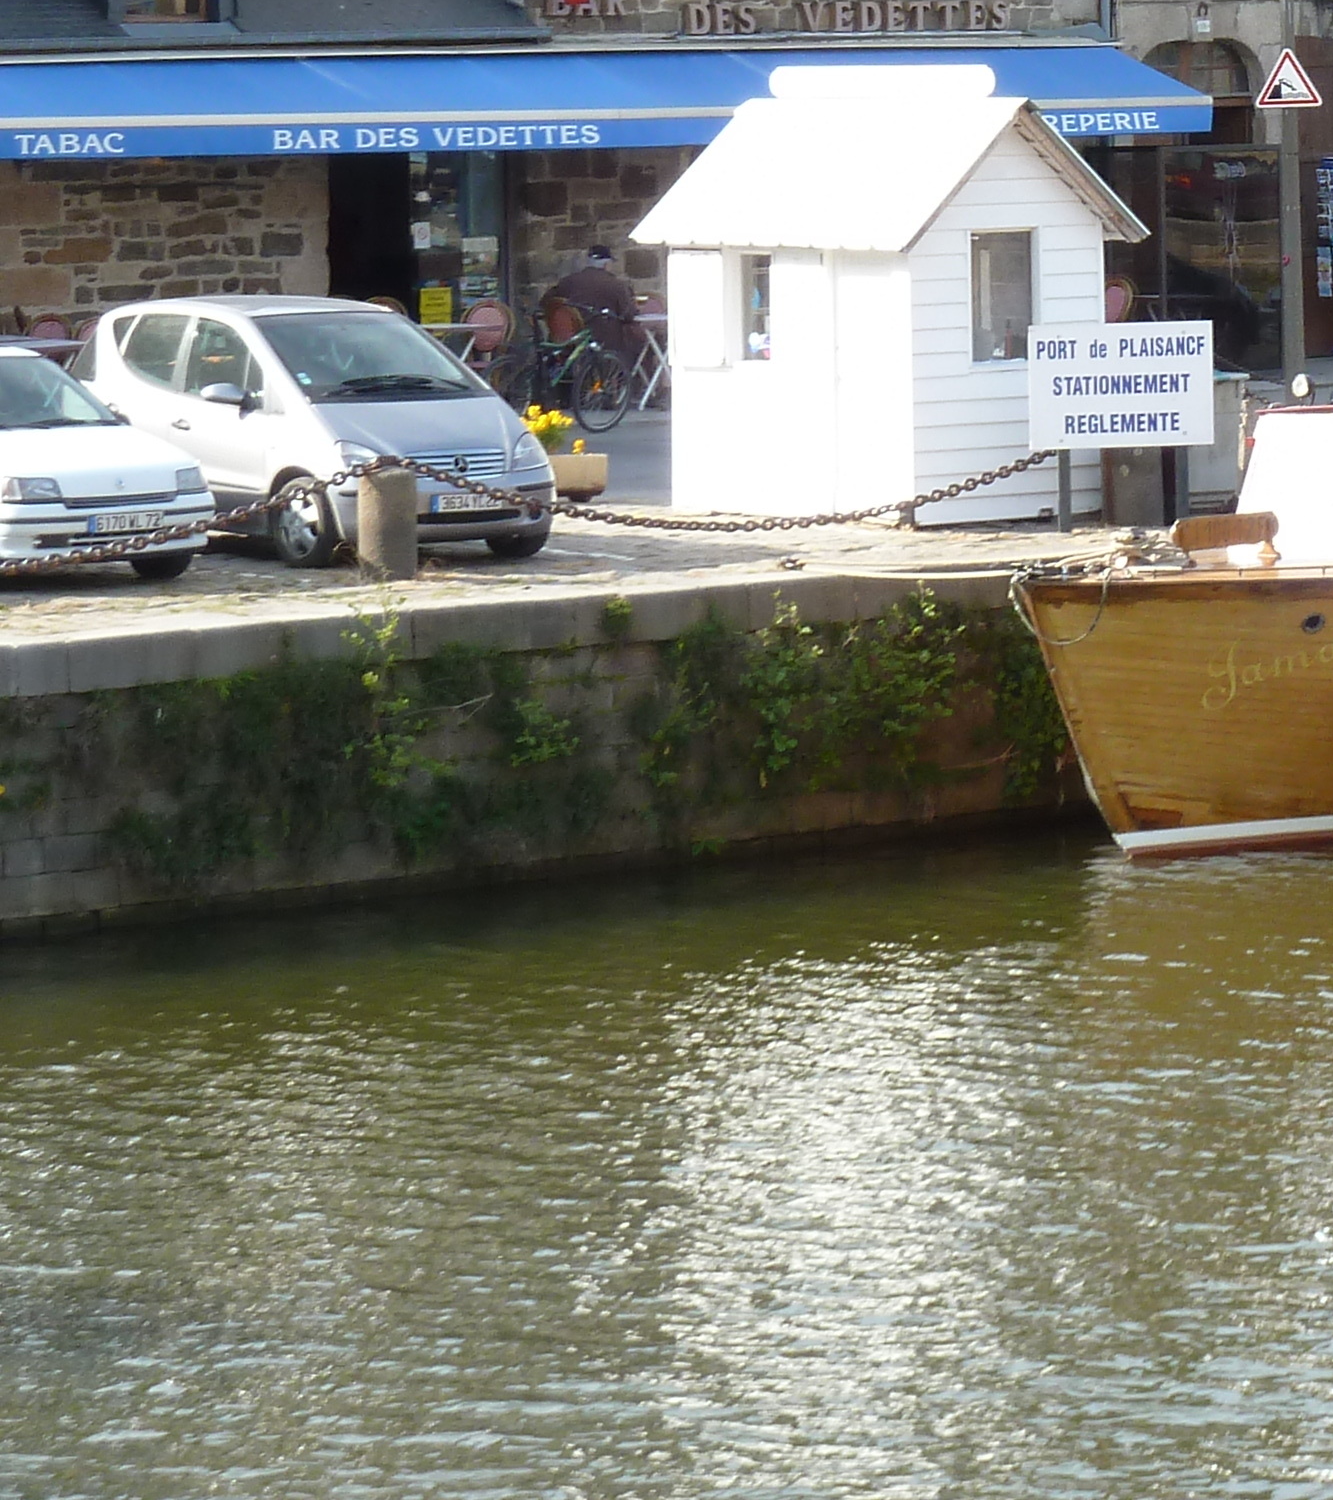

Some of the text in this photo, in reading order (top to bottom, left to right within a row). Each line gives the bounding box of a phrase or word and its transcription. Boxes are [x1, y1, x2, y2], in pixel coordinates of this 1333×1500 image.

[686, 3, 757, 35] DES
[801, 0, 1009, 32] VEDETTES
[14, 111, 1160, 155] TABAC BAR DES VEDETTES REPERIE
[1036, 339, 1077, 360] PORT
[1089, 338, 1107, 358] de
[1053, 373, 1190, 396] STATIONNEMENT
[1065, 412, 1180, 434] REGLEMENTE
[442, 495, 469, 510] 3634
[97, 515, 126, 531] 6170
[145, 512, 160, 527] 72
